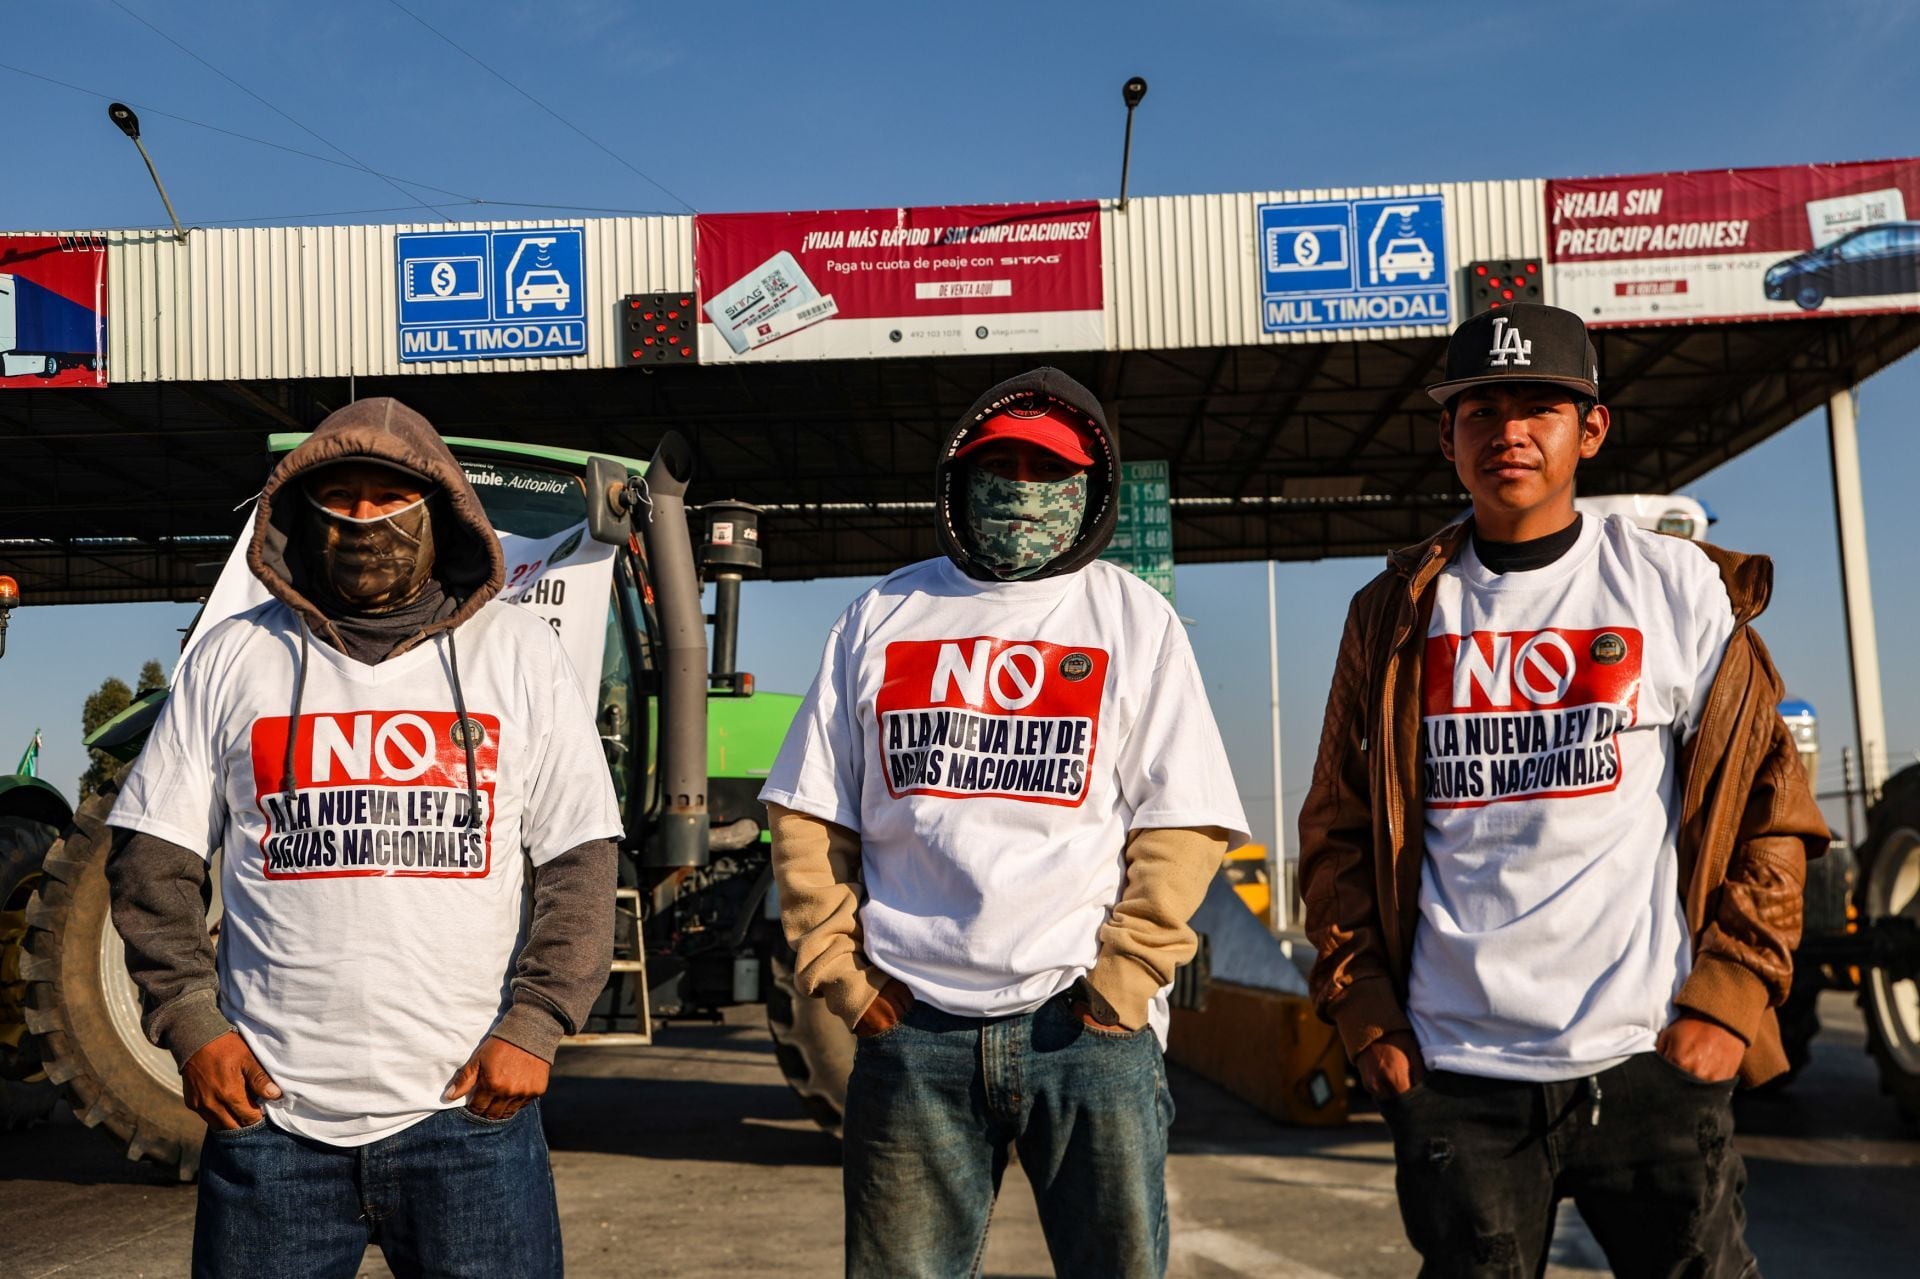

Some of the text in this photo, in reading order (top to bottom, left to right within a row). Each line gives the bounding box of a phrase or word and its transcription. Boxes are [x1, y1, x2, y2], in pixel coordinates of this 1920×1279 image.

[1553, 189, 1663, 224] ¡VIAJA SIN
[801, 221, 1091, 253] ¡VIAJA MÁS RÁPIDO Y SIN COMPLICACIONES!
[1555, 220, 1750, 256] PREOCUPACIONES!
[826, 254, 1061, 274] Paga tu cuota de peaje con SITAG
[938, 284, 949, 297] DE
[951, 283, 973, 297] VENTA
[1268, 295, 1446, 325] MULTIMODAL
[404, 325, 581, 353] MULTIMODAL
[1489, 317, 1532, 366] LA
[465, 469, 568, 494] imble Autopilot
[929, 640, 1045, 711] NO
[1452, 630, 1576, 708] NO
[312, 713, 436, 782] NO
[889, 711, 1087, 756] A LA NUEVA LEY DE
[1434, 719, 1459, 757] LA
[1465, 715, 1547, 756] NUEVA
[1552, 708, 1591, 749] LEY
[947, 752, 1085, 796] NACIONALES
[1491, 743, 1618, 796] NACIONALES
[268, 797, 287, 833] A
[318, 789, 401, 826] NUEVA
[407, 790, 449, 827] LEY
[452, 792, 483, 829] DE
[268, 828, 483, 869] AGUAS NACIONALES
